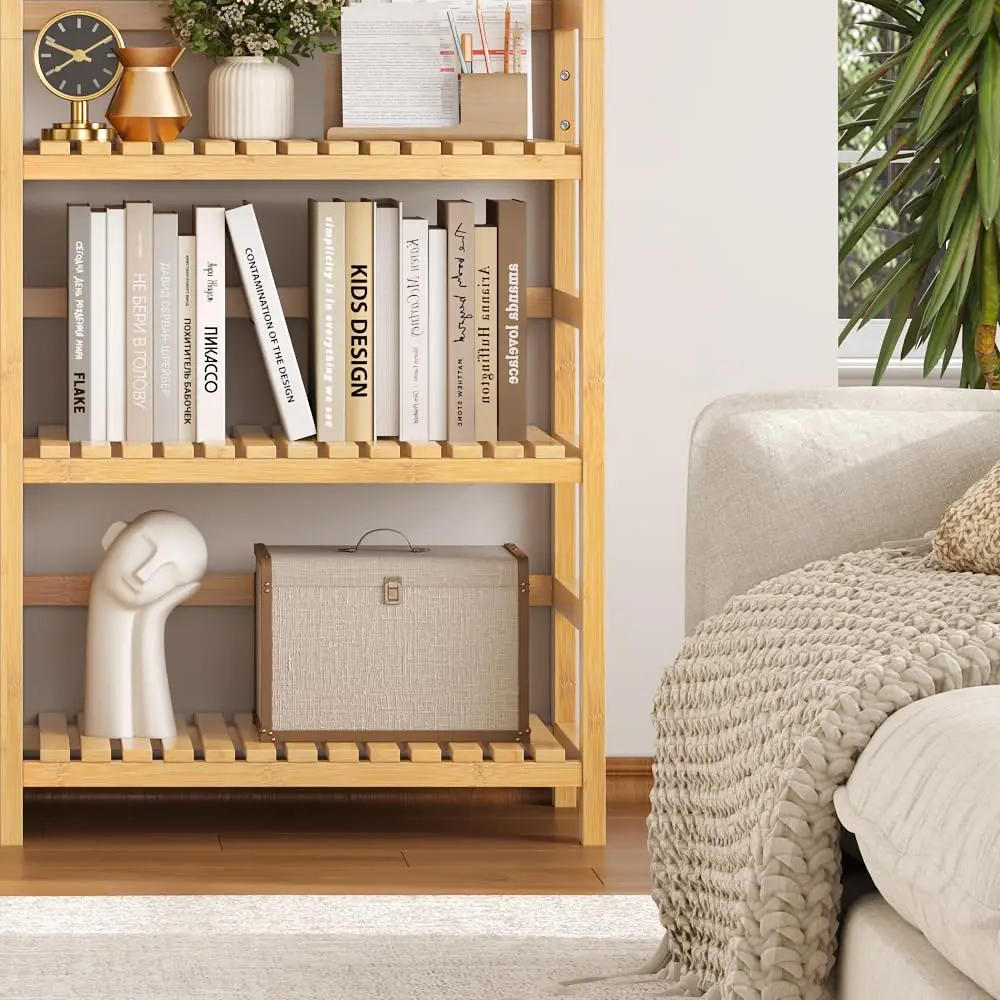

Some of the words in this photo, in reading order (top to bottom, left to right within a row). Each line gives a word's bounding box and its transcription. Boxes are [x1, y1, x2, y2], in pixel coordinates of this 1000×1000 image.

[324, 216, 335, 281] simplicity
[73, 276, 84, 297] ДЕНЬ
[132, 273, 146, 292] НЕ
[160, 262, 171, 298] ДАВИД
[245, 247, 274, 329] CONTAMINATION
[325, 283, 335, 294] is
[351, 264, 368, 313] KIDS
[73, 299, 84, 337] РОЖДЕНИЯ
[132, 296, 146, 333] БЕРИ
[325, 298, 335, 311] in
[74, 339, 84, 360] МИРА
[132, 337, 146, 347] В
[183, 318, 192, 379] ПОХИТИТЕЛЬ
[268, 331, 279, 344] OF
[272, 345, 285, 366] THE
[324, 314, 335, 381] everything
[203, 326, 218, 394] ПИКАССО
[351, 319, 368, 398] DESIGN
[73, 372, 86, 414] FLAKE
[132, 350, 146, 409] ГОЛОВУ
[278, 366, 295, 403] DESIGN
[325, 386, 334, 403] we
[183, 381, 192, 425] БАБОЧЕК
[325, 406, 333, 428] see
